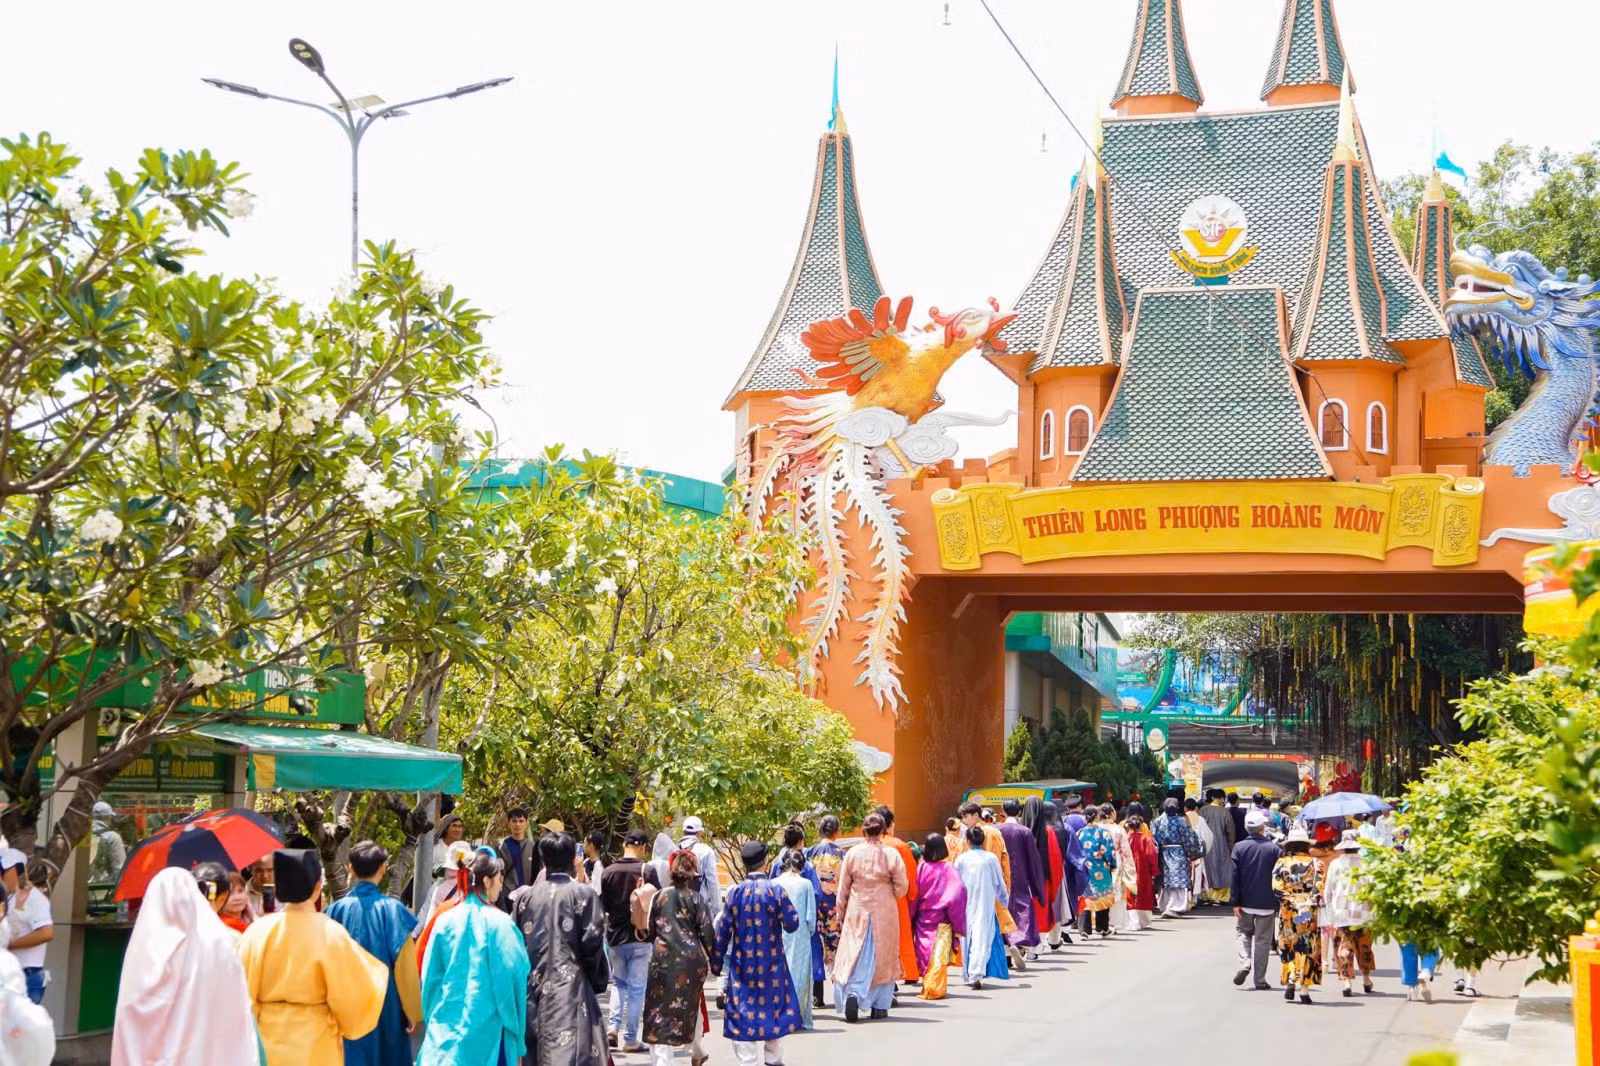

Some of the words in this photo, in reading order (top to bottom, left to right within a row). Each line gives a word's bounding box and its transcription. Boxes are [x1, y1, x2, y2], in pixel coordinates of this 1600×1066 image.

[1023, 508, 1085, 539] THIÊN
[1094, 508, 1147, 532] LONG
[1157, 505, 1240, 533] PHƯỢNG
[1251, 501, 1322, 529] HOÀNG
[1333, 504, 1385, 534] MÔN
